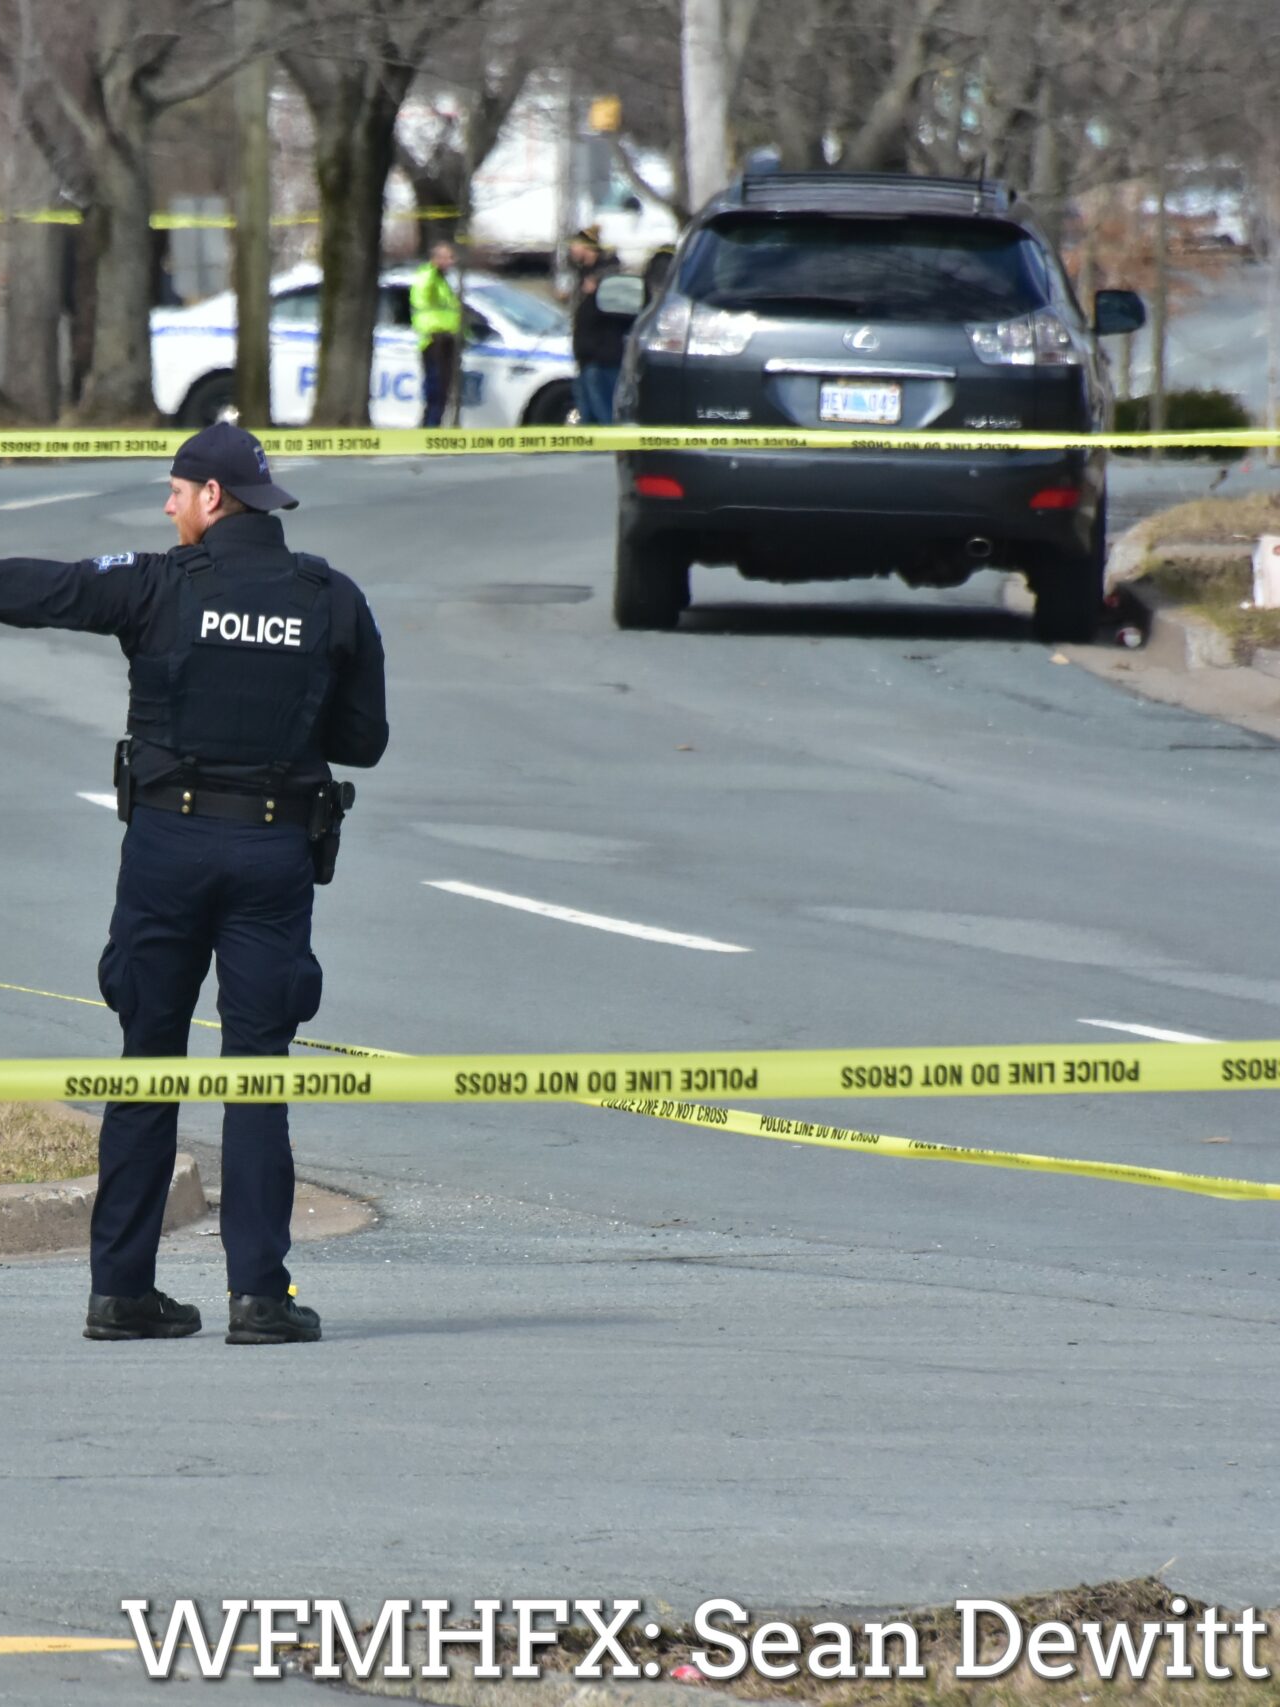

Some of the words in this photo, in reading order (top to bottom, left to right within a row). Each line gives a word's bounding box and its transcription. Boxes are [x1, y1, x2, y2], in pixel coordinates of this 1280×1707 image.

[0, 441, 41, 452] CROSS
[45, 441, 69, 452] NOT
[73, 441, 90, 452] DO
[94, 440, 120, 451] LINE
[125, 440, 167, 451] POLICE
[264, 439, 280, 451] NO
[284, 439, 302, 450] DO
[307, 438, 333, 450] LINE
[337, 438, 380, 449] POLICE
[426, 437, 466, 449] CROSS
[470, 437, 494, 448] NOT
[498, 437, 515, 448] DO
[519, 436, 546, 447] LINE
[550, 436, 594, 447] POLICE
[640, 437, 679, 446] CROSS
[684, 437, 708, 446] NOT
[711, 437, 728, 446] DO
[733, 437, 759, 446] LINE
[763, 437, 807, 447] POLICE
[200, 610, 302, 646] POLICE
[841, 1065, 913, 1089] CROSS
[920, 1064, 963, 1088] NOT
[971, 1063, 1001, 1086] DO
[1008, 1062, 1055, 1085] LINE
[1063, 1060, 1140, 1083] POLICE
[1221, 1058, 1280, 1081] ROSS
[64, 1077, 139, 1097] CROSS
[145, 1076, 190, 1097] NOT
[198, 1076, 228, 1096] DO
[236, 1075, 285, 1096] LINE
[292, 1073, 371, 1096] POLICE
[454, 1072, 528, 1095] CROSS
[534, 1071, 579, 1094] NOT
[587, 1071, 617, 1093] DO
[625, 1070, 672, 1093] LINE
[680, 1068, 758, 1091] POLICE
[600, 1098, 636, 1112] POLICE
[636, 1098, 659, 1116] LINE
[659, 1100, 675, 1118] DO
[674, 1102, 697, 1120] NOT
[696, 1105, 729, 1125] CROSS
[760, 1114, 793, 1135] POLICE
[793, 1120, 815, 1137] LINE
